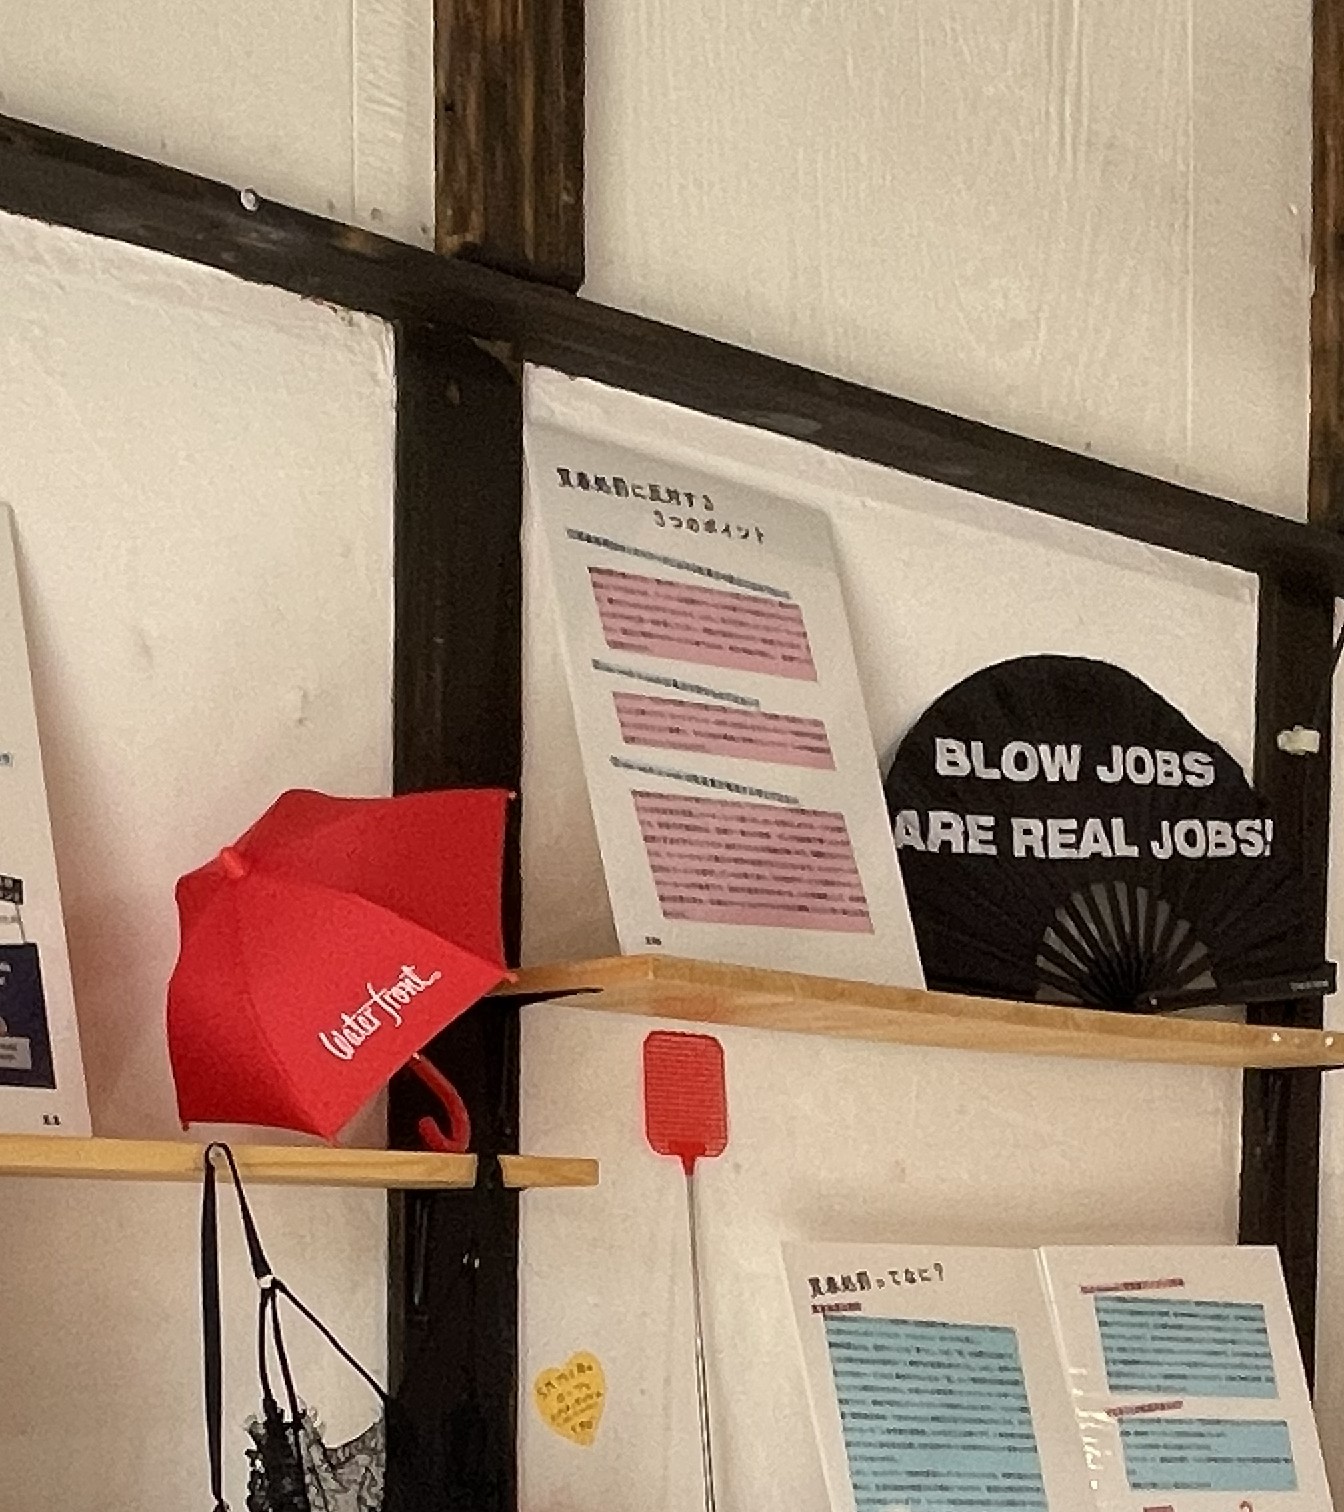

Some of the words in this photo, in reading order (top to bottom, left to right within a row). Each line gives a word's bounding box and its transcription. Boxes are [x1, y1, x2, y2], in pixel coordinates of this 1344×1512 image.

[935, 738, 1082, 782] BLOW
[1096, 745, 1216, 787] JOBS
[894, 810, 998, 855] ARE
[1011, 817, 1139, 859] REAL
[1150, 818, 1274, 859] JOBS!
